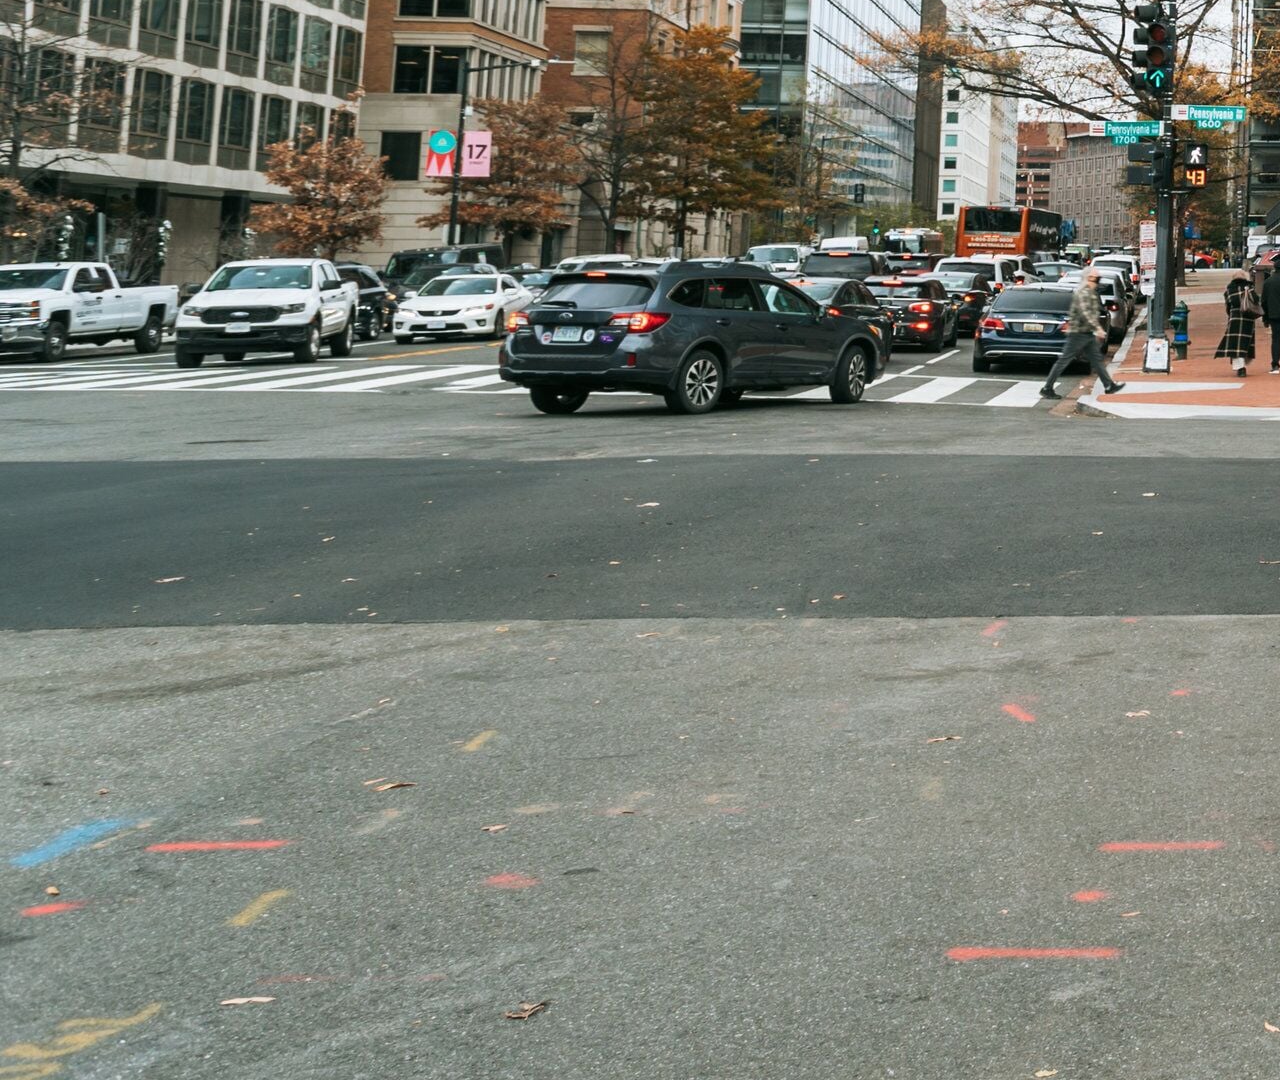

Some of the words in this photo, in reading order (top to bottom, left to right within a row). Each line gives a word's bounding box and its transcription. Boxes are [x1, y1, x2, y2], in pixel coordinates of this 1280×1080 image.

[1190, 106, 1234, 121] Pennsylvania
[1107, 123, 1150, 136] Pennsylvania
[1197, 120, 1221, 128] 1600
[1115, 136, 1137, 144] 1700
[467, 144, 488, 160] 17
[1186, 170, 1205, 185] 43
